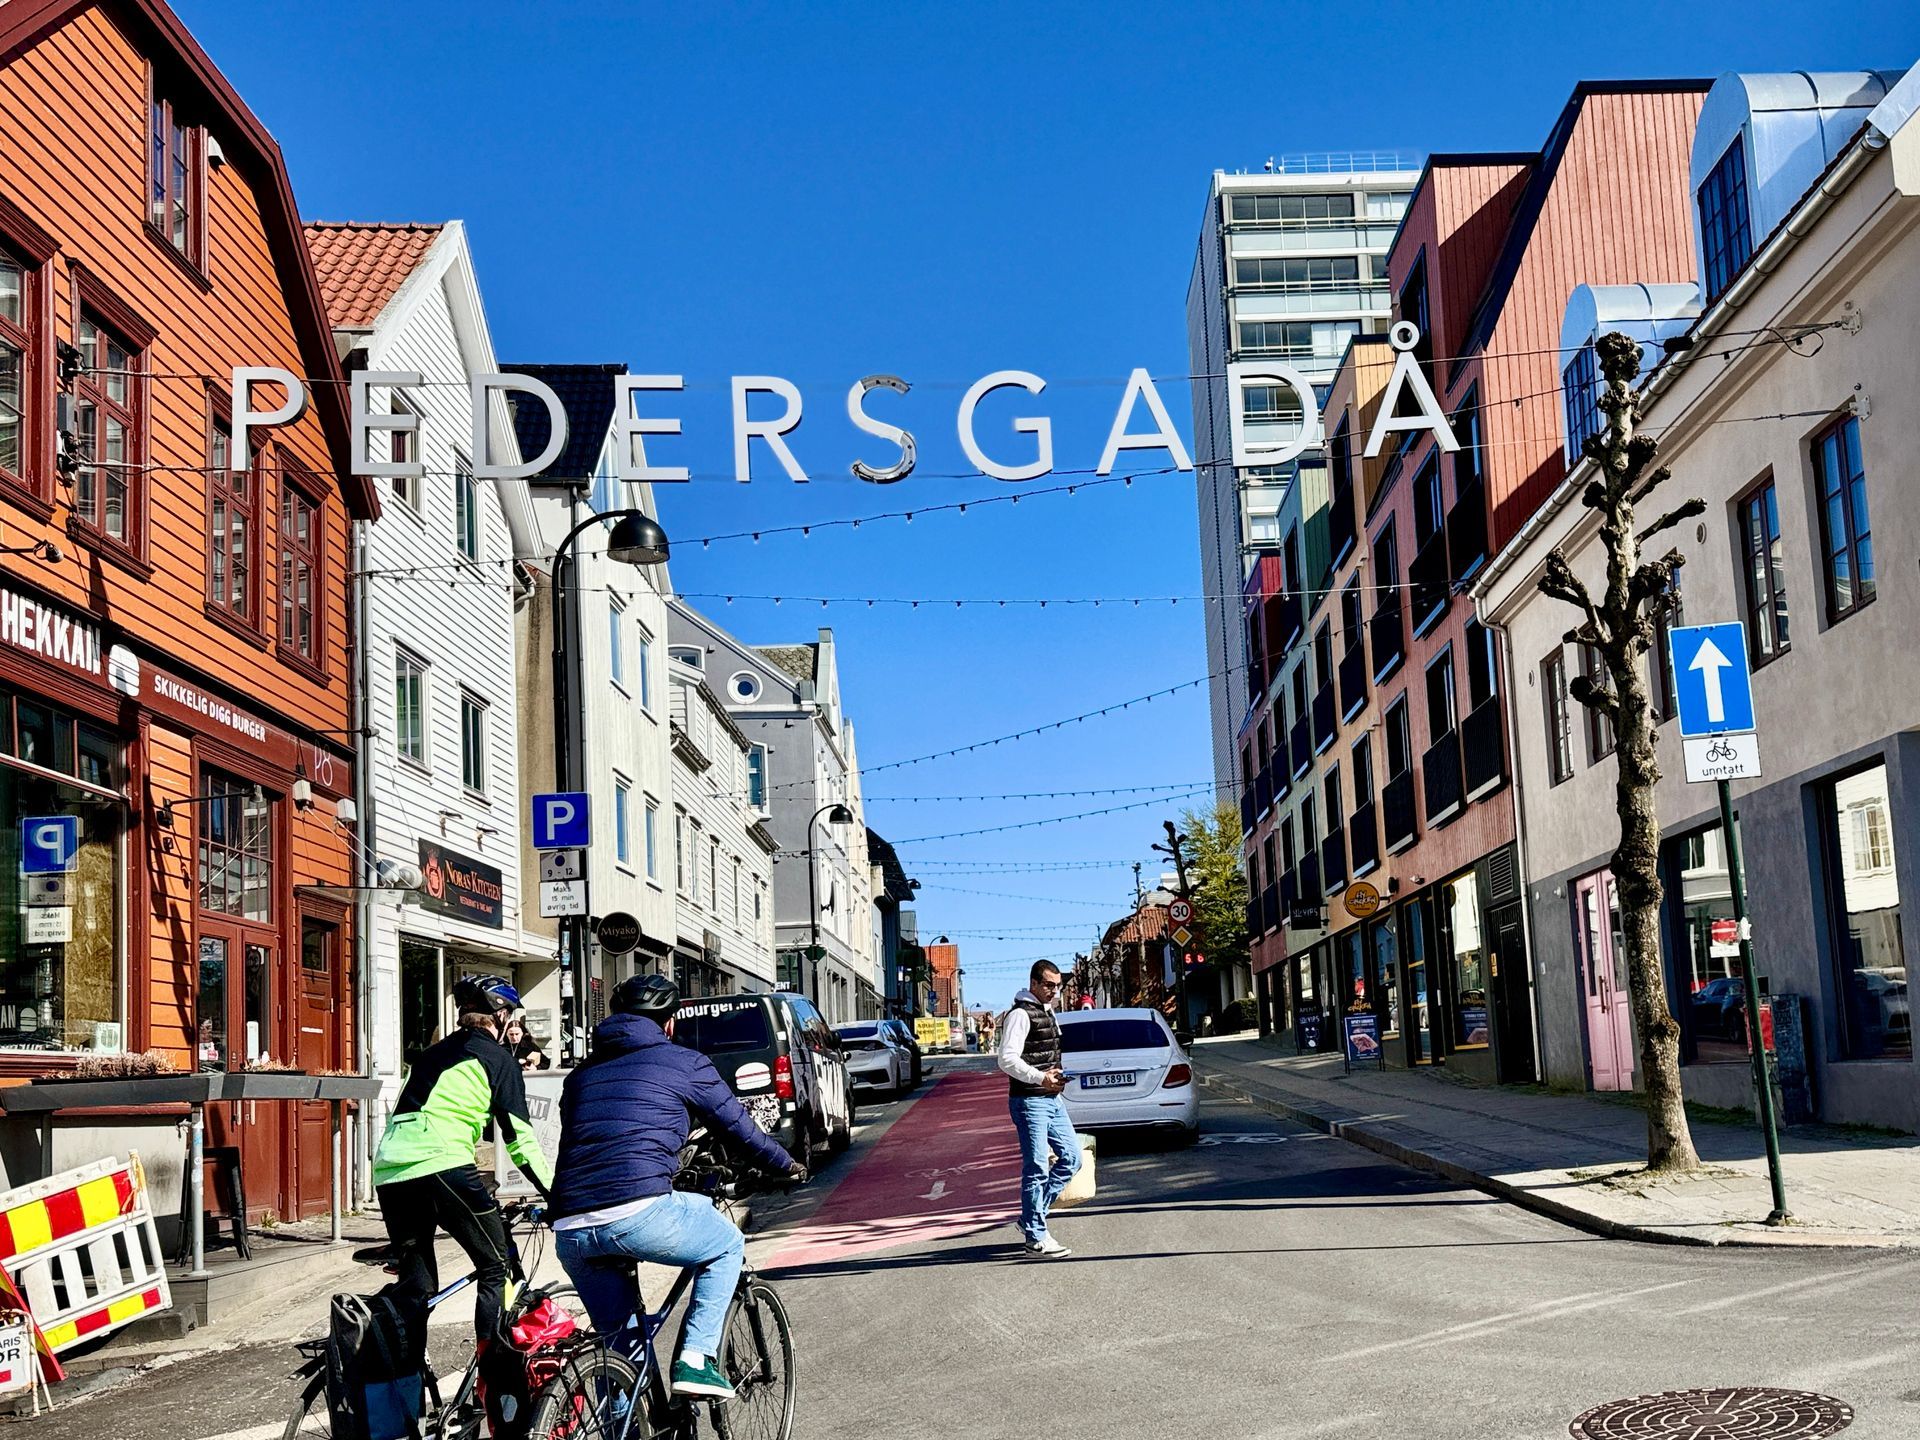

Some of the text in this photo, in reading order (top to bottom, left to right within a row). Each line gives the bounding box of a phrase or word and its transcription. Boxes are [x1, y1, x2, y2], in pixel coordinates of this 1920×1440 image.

[231, 320, 1461, 484] PEDERSGADÅ
[1, 588, 101, 676] HEKKAN
[154, 674, 266, 743] SKIKKELIG DIGG BURGER
[1702, 764, 1744, 776] unntatt
[547, 800, 575, 840] P
[547, 869, 553, 877] 9
[565, 867, 573, 876] 12
[471, 870, 501, 901] KITCHEN
[570, 902, 579, 910] tid
[1172, 905, 1189, 918] 30
[601, 926, 637, 938] Miyako
[1090, 1074, 1132, 1085] BT 58918
